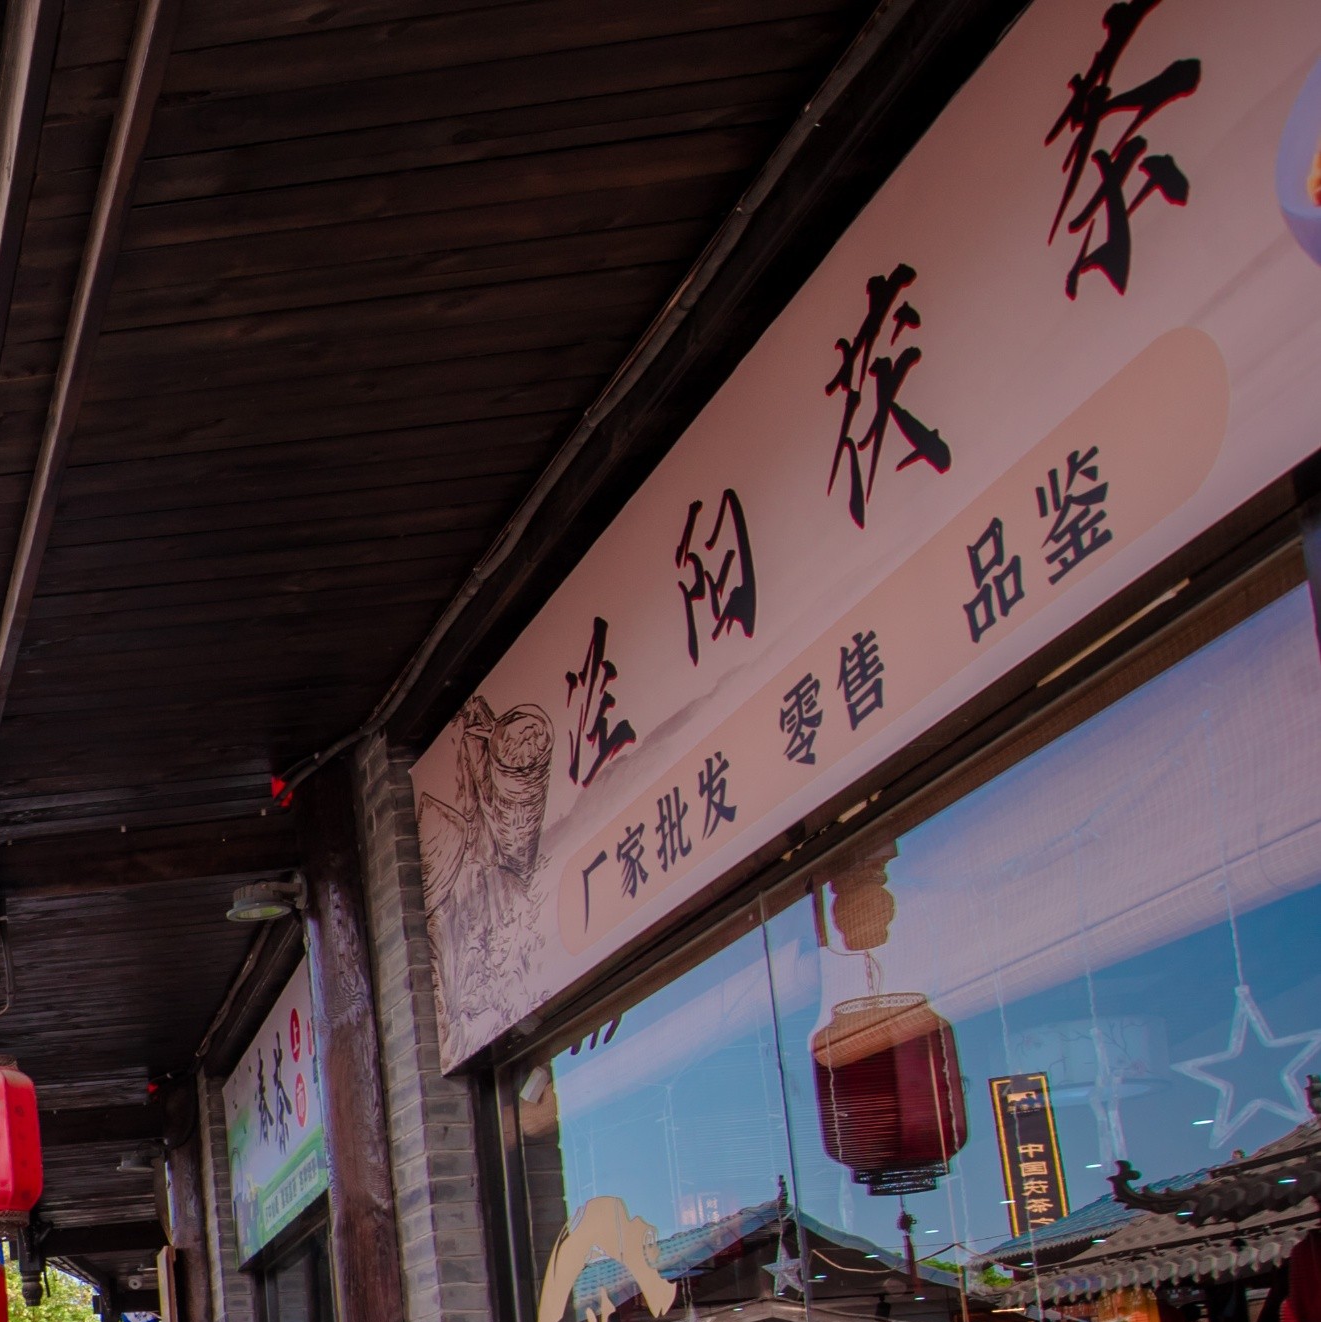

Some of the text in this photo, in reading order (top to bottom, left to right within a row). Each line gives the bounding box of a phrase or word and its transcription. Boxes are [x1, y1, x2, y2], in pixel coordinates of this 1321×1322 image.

[581, 446, 1113, 932] 厂家批发 零售 品鉴
